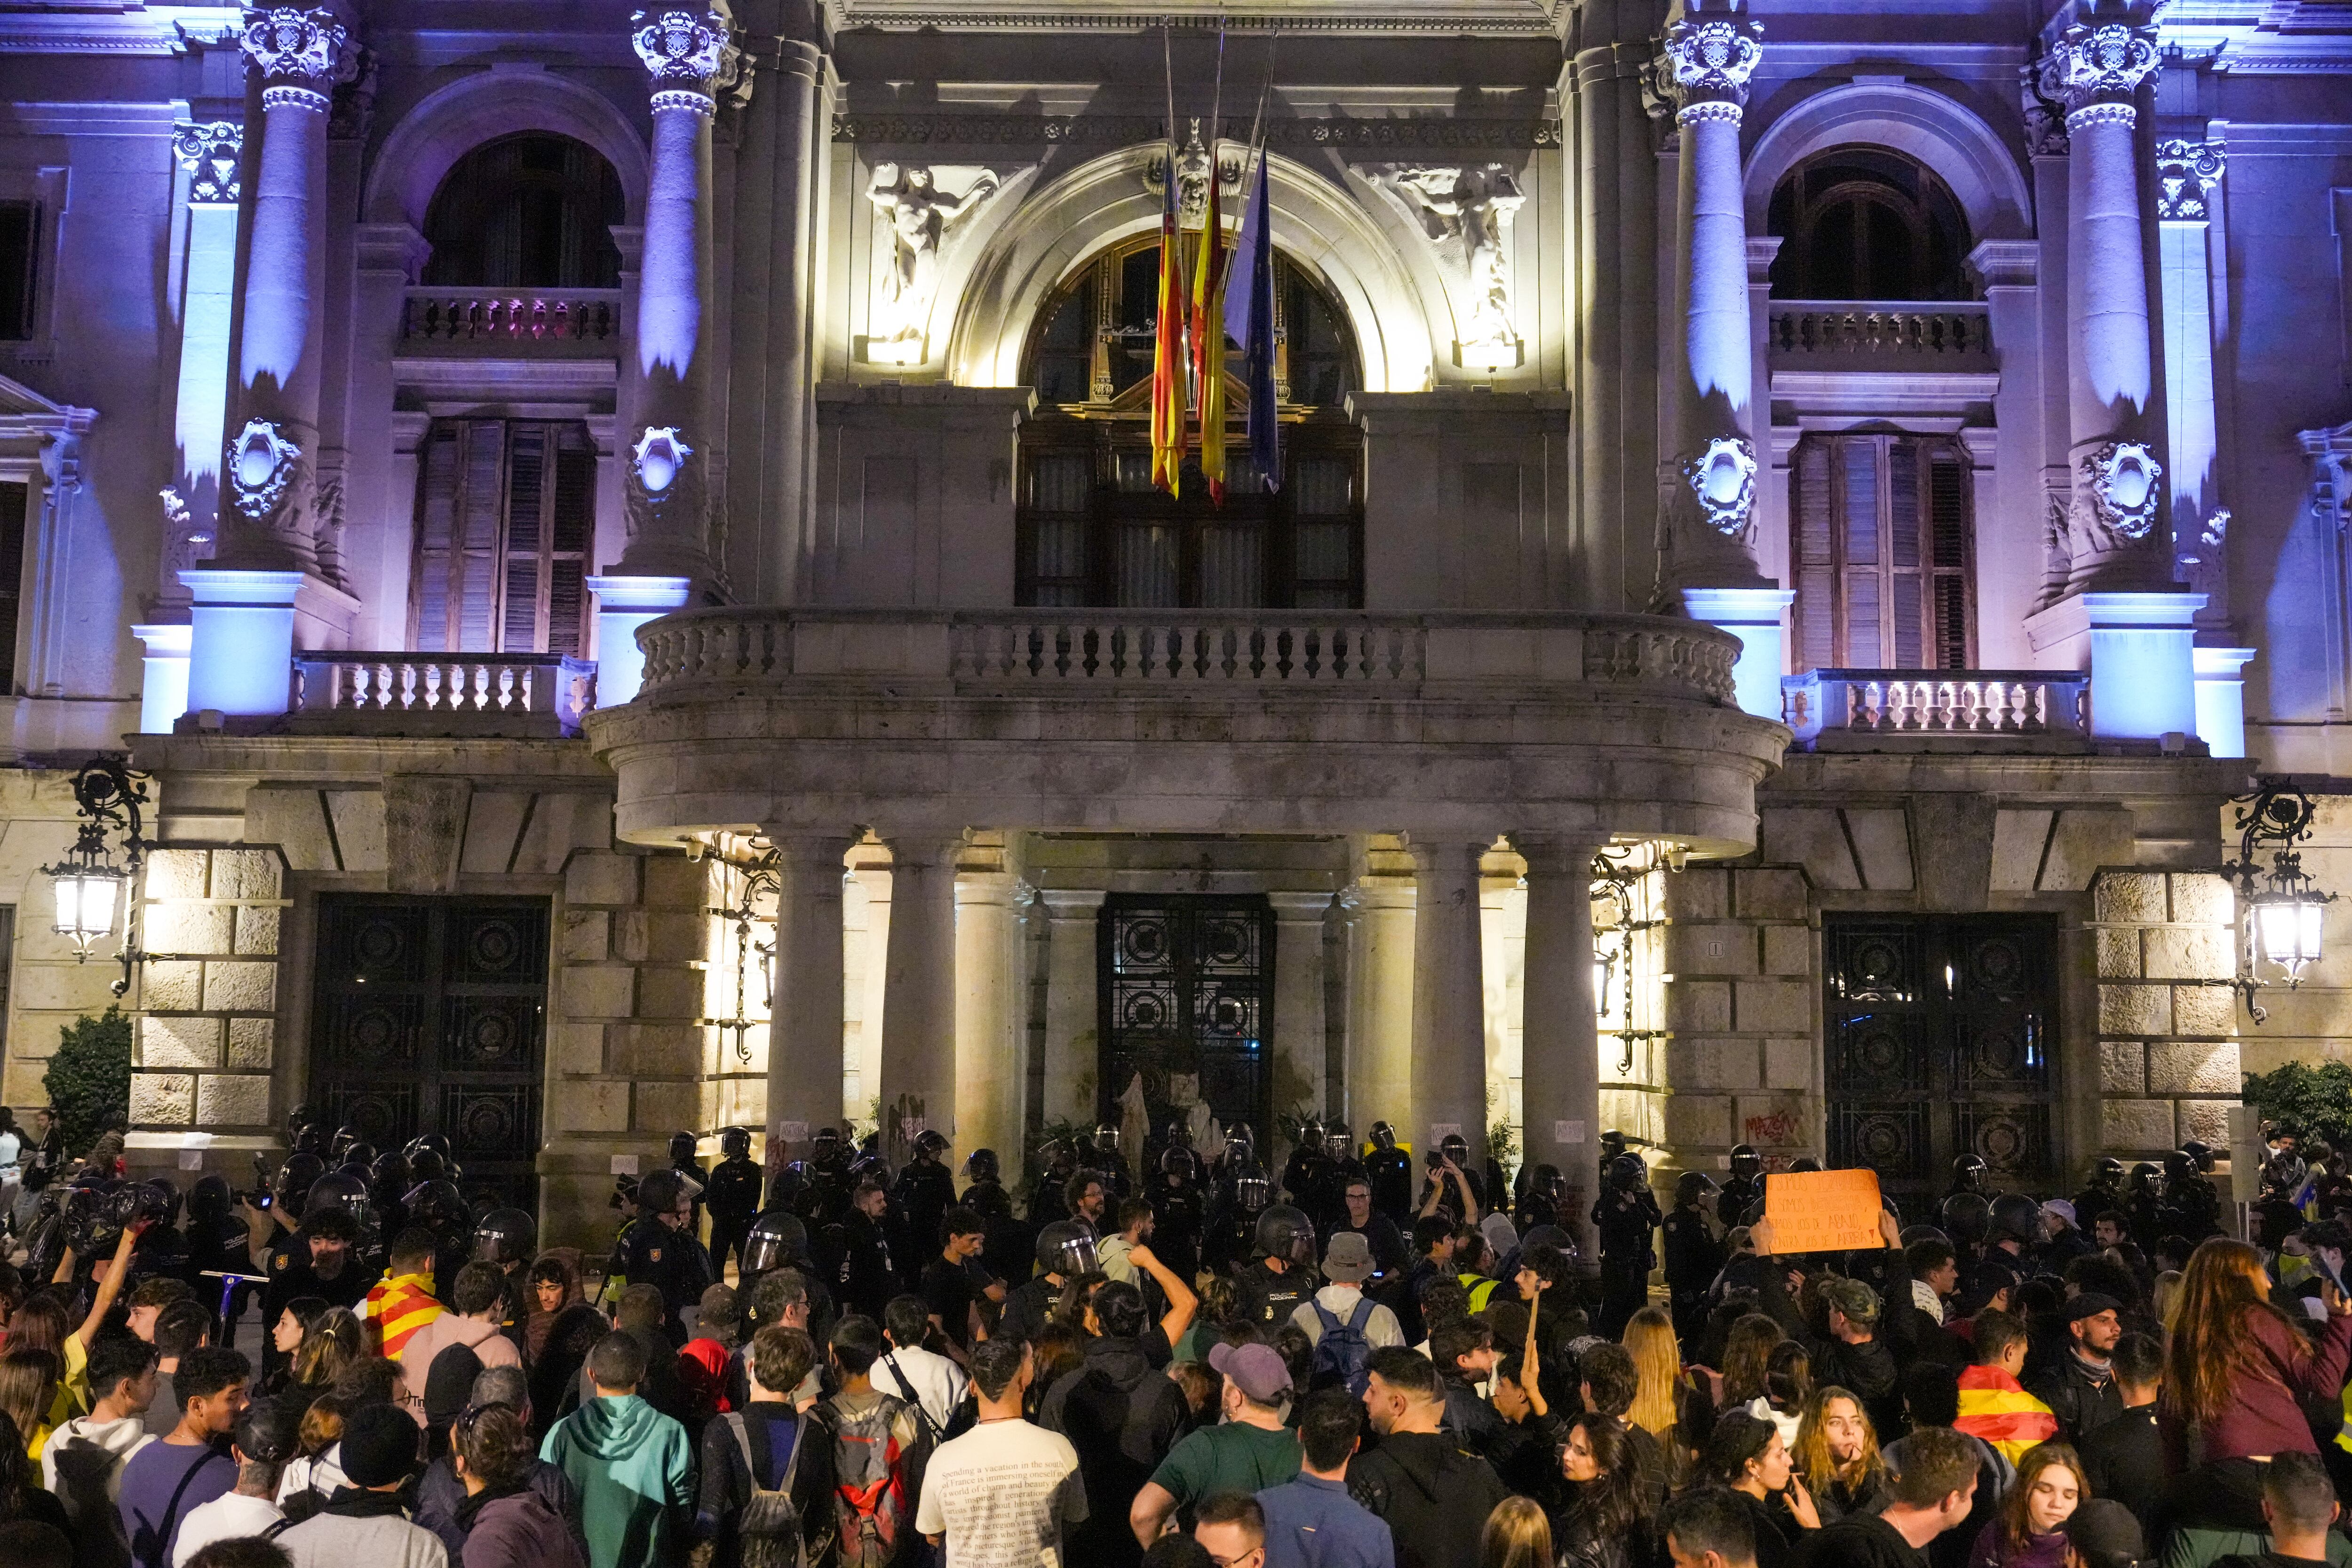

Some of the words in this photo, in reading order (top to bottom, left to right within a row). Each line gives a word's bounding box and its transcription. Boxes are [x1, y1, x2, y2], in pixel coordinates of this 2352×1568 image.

[1714, 943, 1717, 955] 1
[1778, 1197, 1805, 1213] SOMOS
[1797, 1218, 1810, 1230] LOS
[1813, 1218, 1822, 1230] DE
[1806, 1235, 1817, 1247] LOS
[1821, 1234, 1831, 1247] DE
[942, 1467, 974, 1480] Spending
[985, 1464, 1018, 1472] vacation
[951, 1478, 975, 1487] France
[986, 1472, 1027, 1481] immersing
[948, 1487, 969, 1496] world
[972, 1484, 980, 1493] of
[1009, 1480, 1022, 1489] and
[1025, 1480, 1049, 1488] beauty
[965, 1492, 995, 1504] inspired
[1005, 1489, 1049, 1501] generations
[970, 1502, 1010, 1513] throughout
[963, 1512, 1009, 1522] impressionist
[1016, 1509, 1044, 1519] painters
[952, 1523, 979, 1533] captured
[993, 1520, 1020, 1530] region's
[1019, 1527, 1039, 1536] found
[975, 1541, 1015, 1552] picturesque
[954, 1551, 990, 1561] landscapes,
[1014, 1547, 1035, 1556] corner
[1011, 1557, 1033, 1566] refuge
